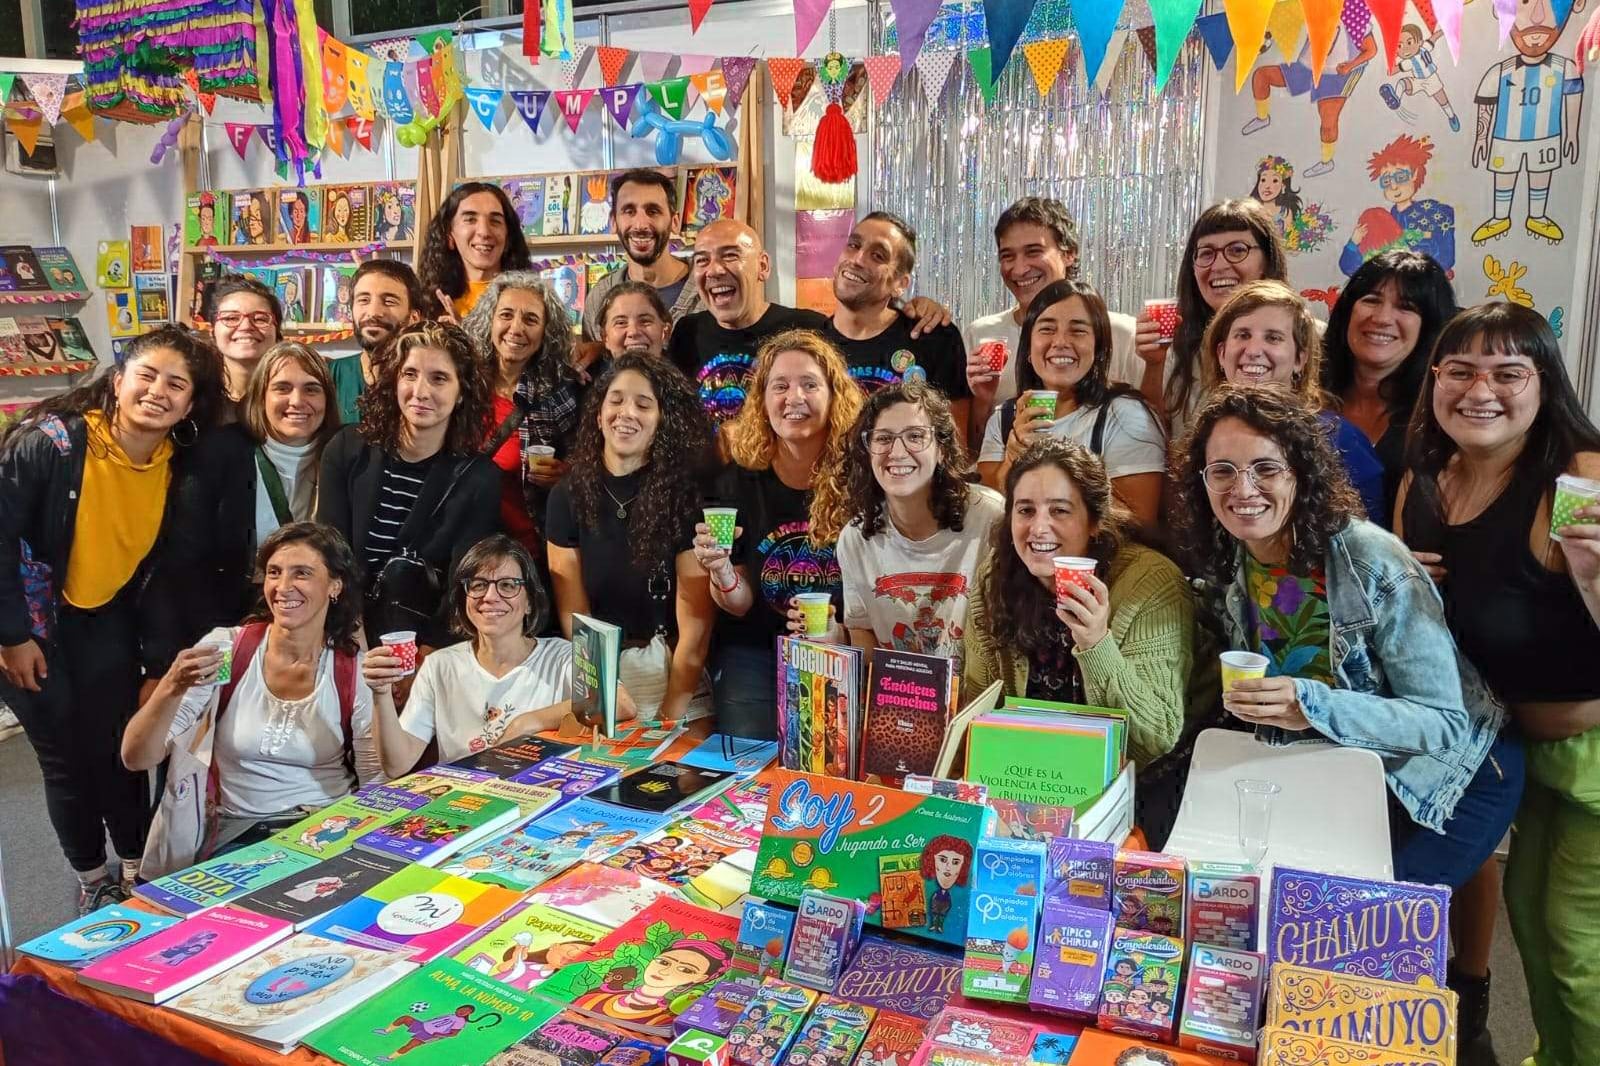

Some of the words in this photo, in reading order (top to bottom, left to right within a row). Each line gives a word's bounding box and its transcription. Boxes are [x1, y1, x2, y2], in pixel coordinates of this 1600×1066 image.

[1519, 87, 1540, 105] 10
[1539, 148, 1556, 164] 10
[791, 645, 843, 682] ORGULLO
[1036, 768, 1048, 779] ES
[1050, 770, 1063, 780] LA
[770, 777, 856, 855] Soy
[858, 794, 885, 826] 2
[836, 835, 887, 858] Jugando
[891, 838, 901, 849] a
[903, 834, 926, 849] Ser
[178, 870, 237, 897] DITA
[1115, 870, 1178, 889] Empoderadas
[1198, 881, 1249, 899] BARDO
[526, 915, 565, 937] Papel
[1277, 898, 1440, 965] CHAMUYO
[1113, 936, 1178, 954] Empoderadas
[1201, 951, 1253, 971] BARDO
[460, 984, 477, 997] LA
[474, 990, 520, 1016] NÚMERO
